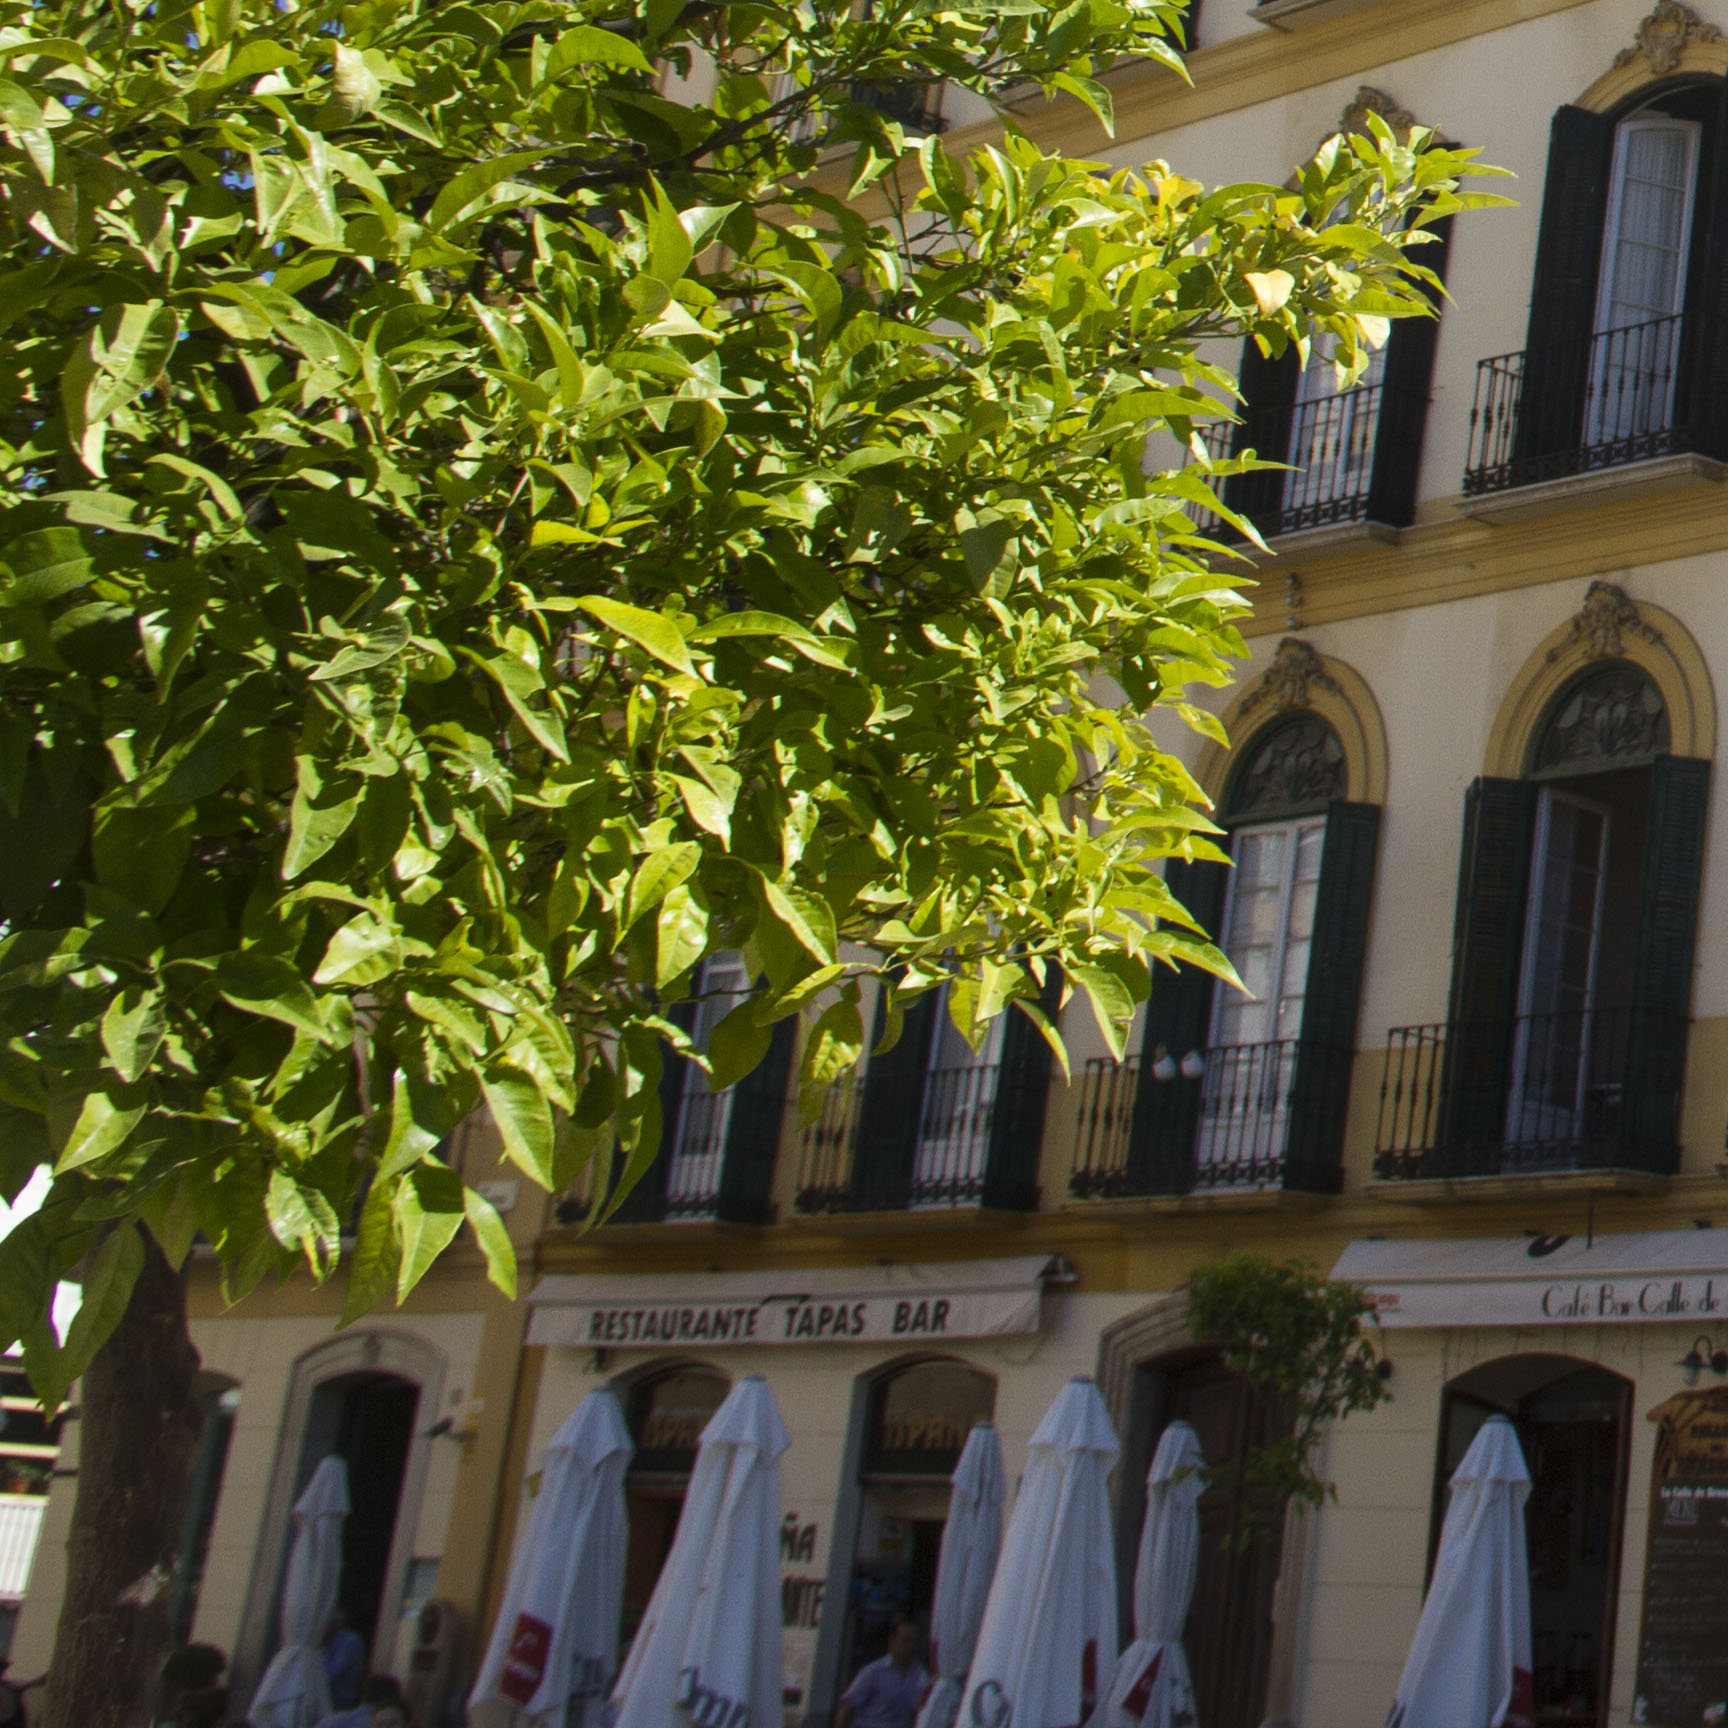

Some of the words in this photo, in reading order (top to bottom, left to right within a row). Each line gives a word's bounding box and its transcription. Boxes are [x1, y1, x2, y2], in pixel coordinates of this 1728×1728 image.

[1542, 1283, 1592, 1318] Café
[1599, 1283, 1635, 1316] Bar
[1639, 1281, 1690, 1314] Calle
[1699, 1280, 1721, 1311] de
[588, 1306, 759, 1341] RESTAURANTE
[784, 1301, 867, 1338] TAPAS
[892, 1298, 952, 1335] BAR
